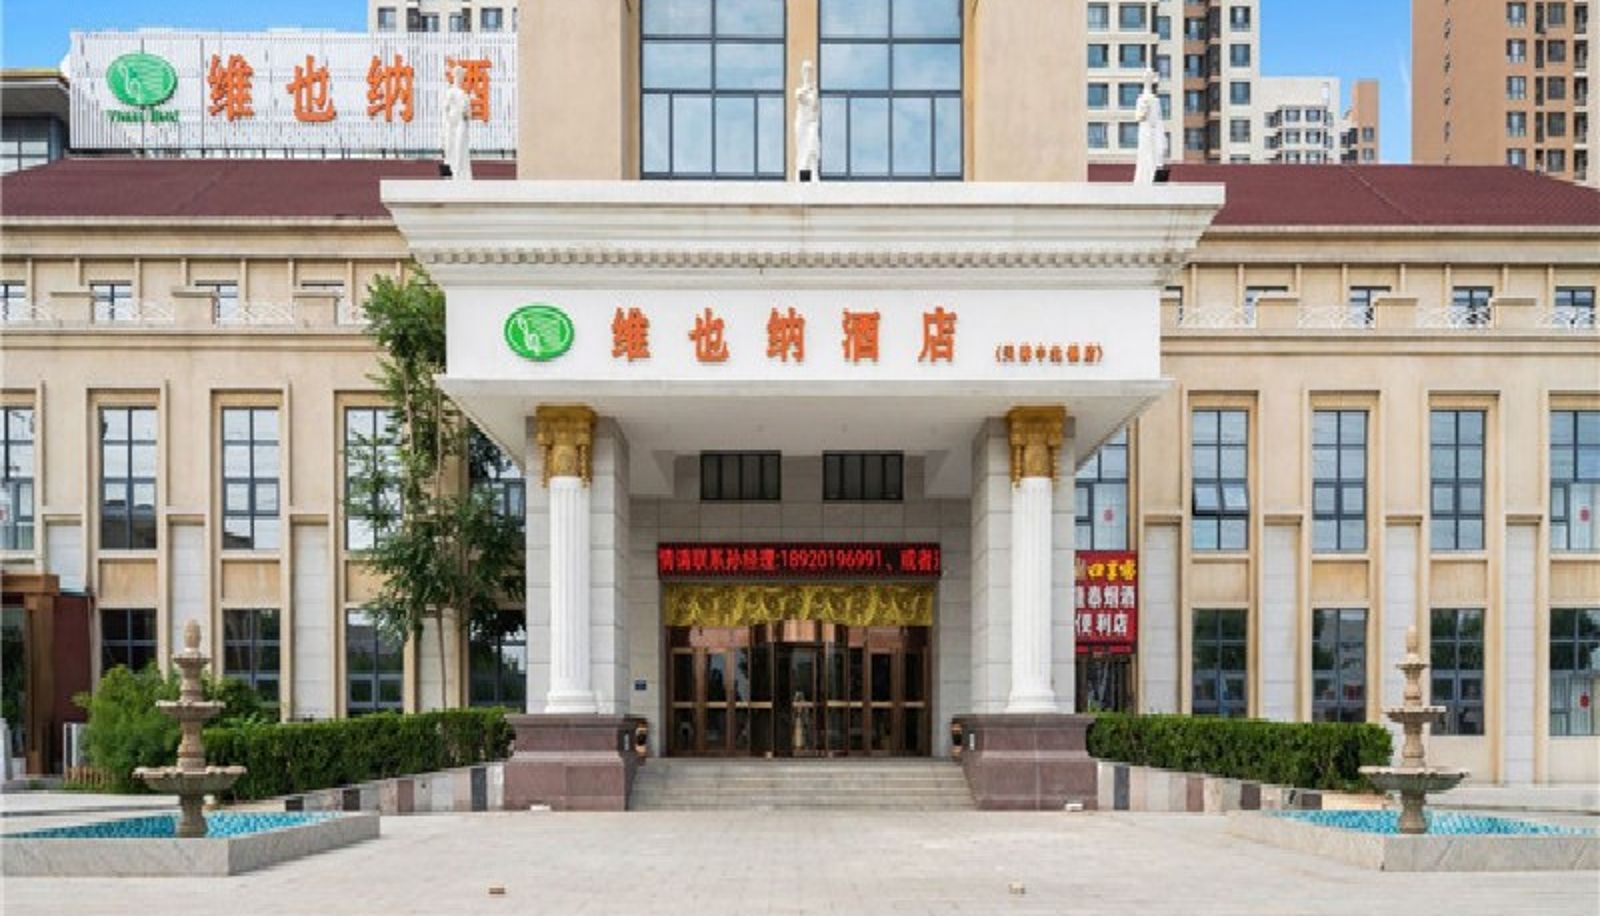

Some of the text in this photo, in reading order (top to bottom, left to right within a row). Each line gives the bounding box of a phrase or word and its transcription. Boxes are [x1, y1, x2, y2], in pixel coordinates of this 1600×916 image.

[207, 54, 492, 123] 维也纳酒
[611, 306, 957, 364] 维也纳酒店
[1075, 611, 1129, 637] 便利店
